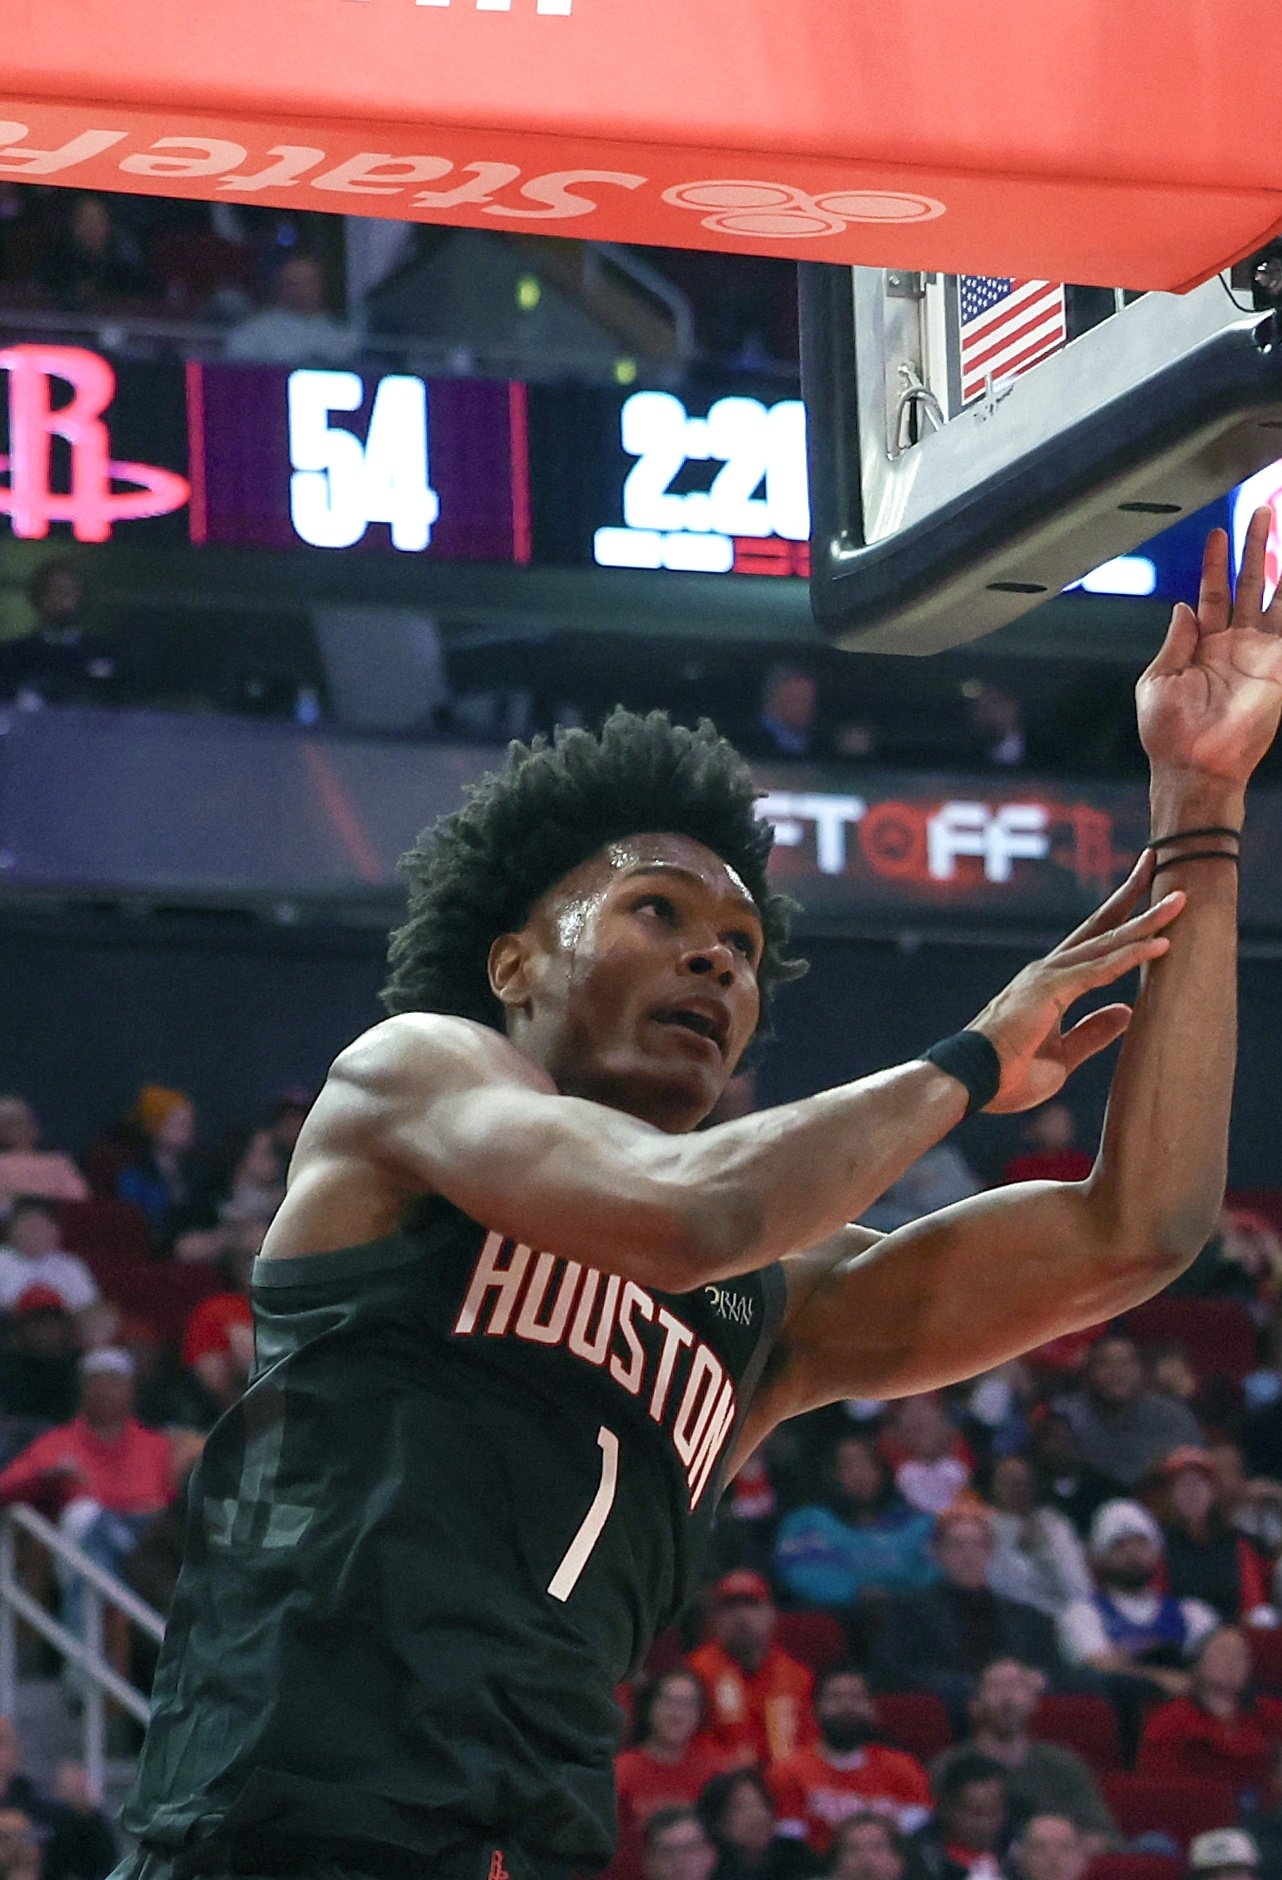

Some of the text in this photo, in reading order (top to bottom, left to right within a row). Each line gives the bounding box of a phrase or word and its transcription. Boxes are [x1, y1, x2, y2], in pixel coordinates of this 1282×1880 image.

[0, 120, 648, 219] StateF
[288, 369, 440, 552] 54
[451, 1230, 737, 1515] HOUSTON
[547, 1425, 620, 1602] 1
